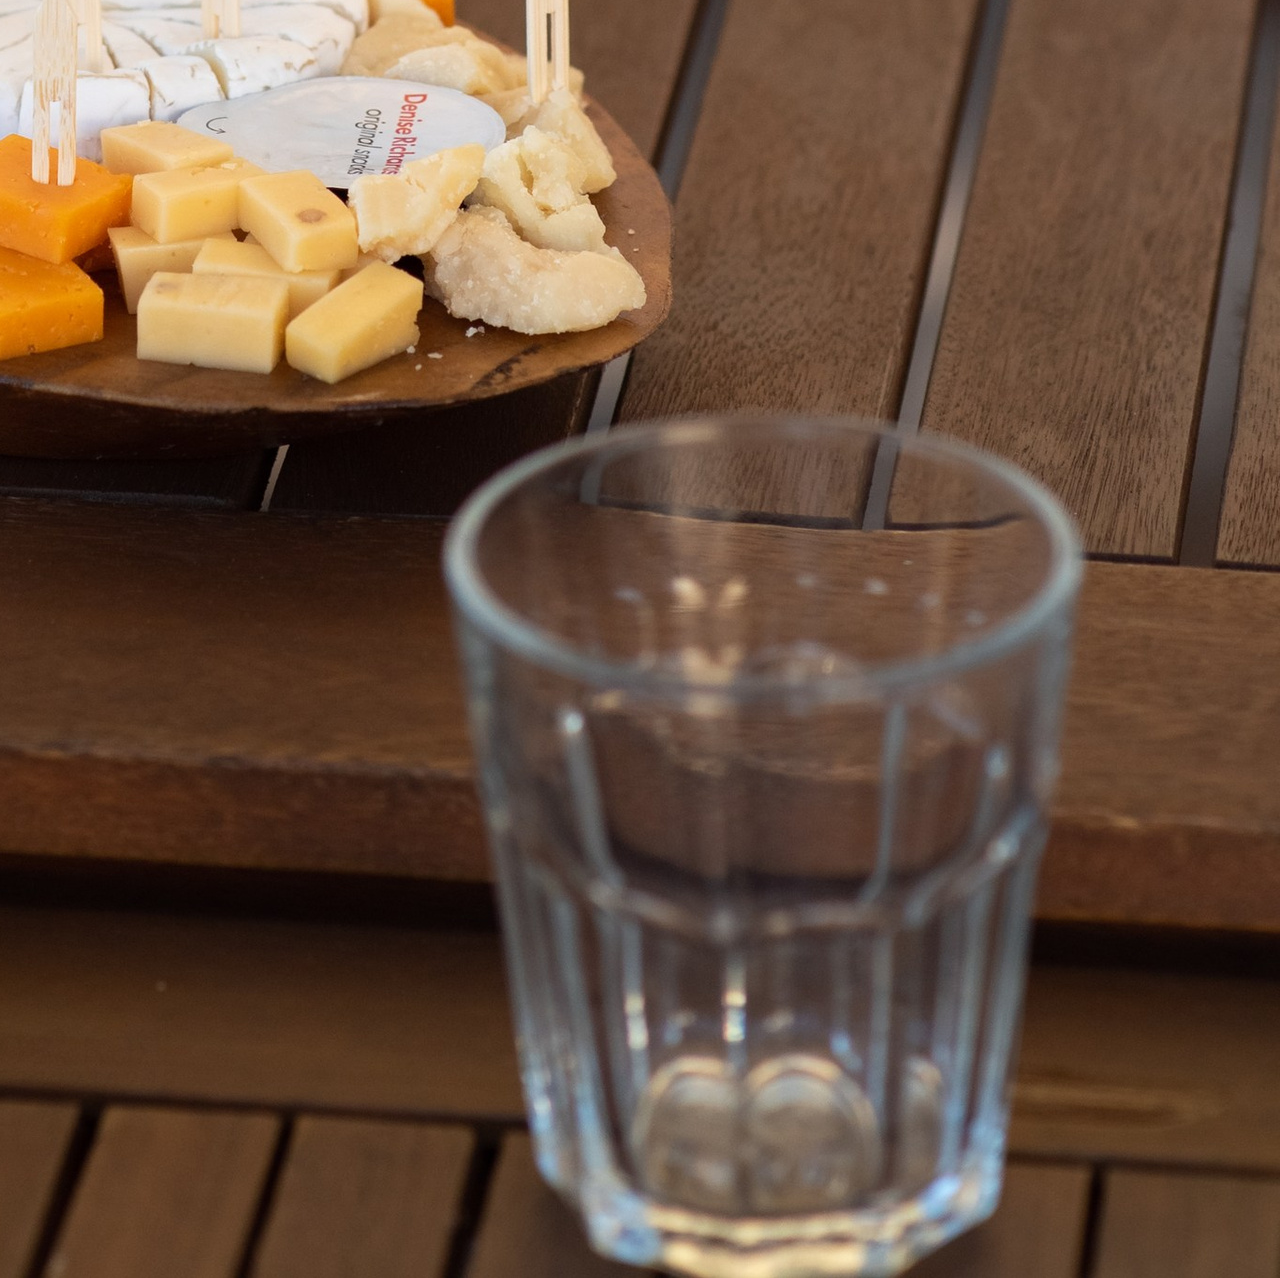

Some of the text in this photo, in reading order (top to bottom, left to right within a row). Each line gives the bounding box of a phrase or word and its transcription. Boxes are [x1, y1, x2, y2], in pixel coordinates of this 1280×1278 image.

[395, 94, 427, 135] Denise
[347, 109, 386, 175] original snacks
